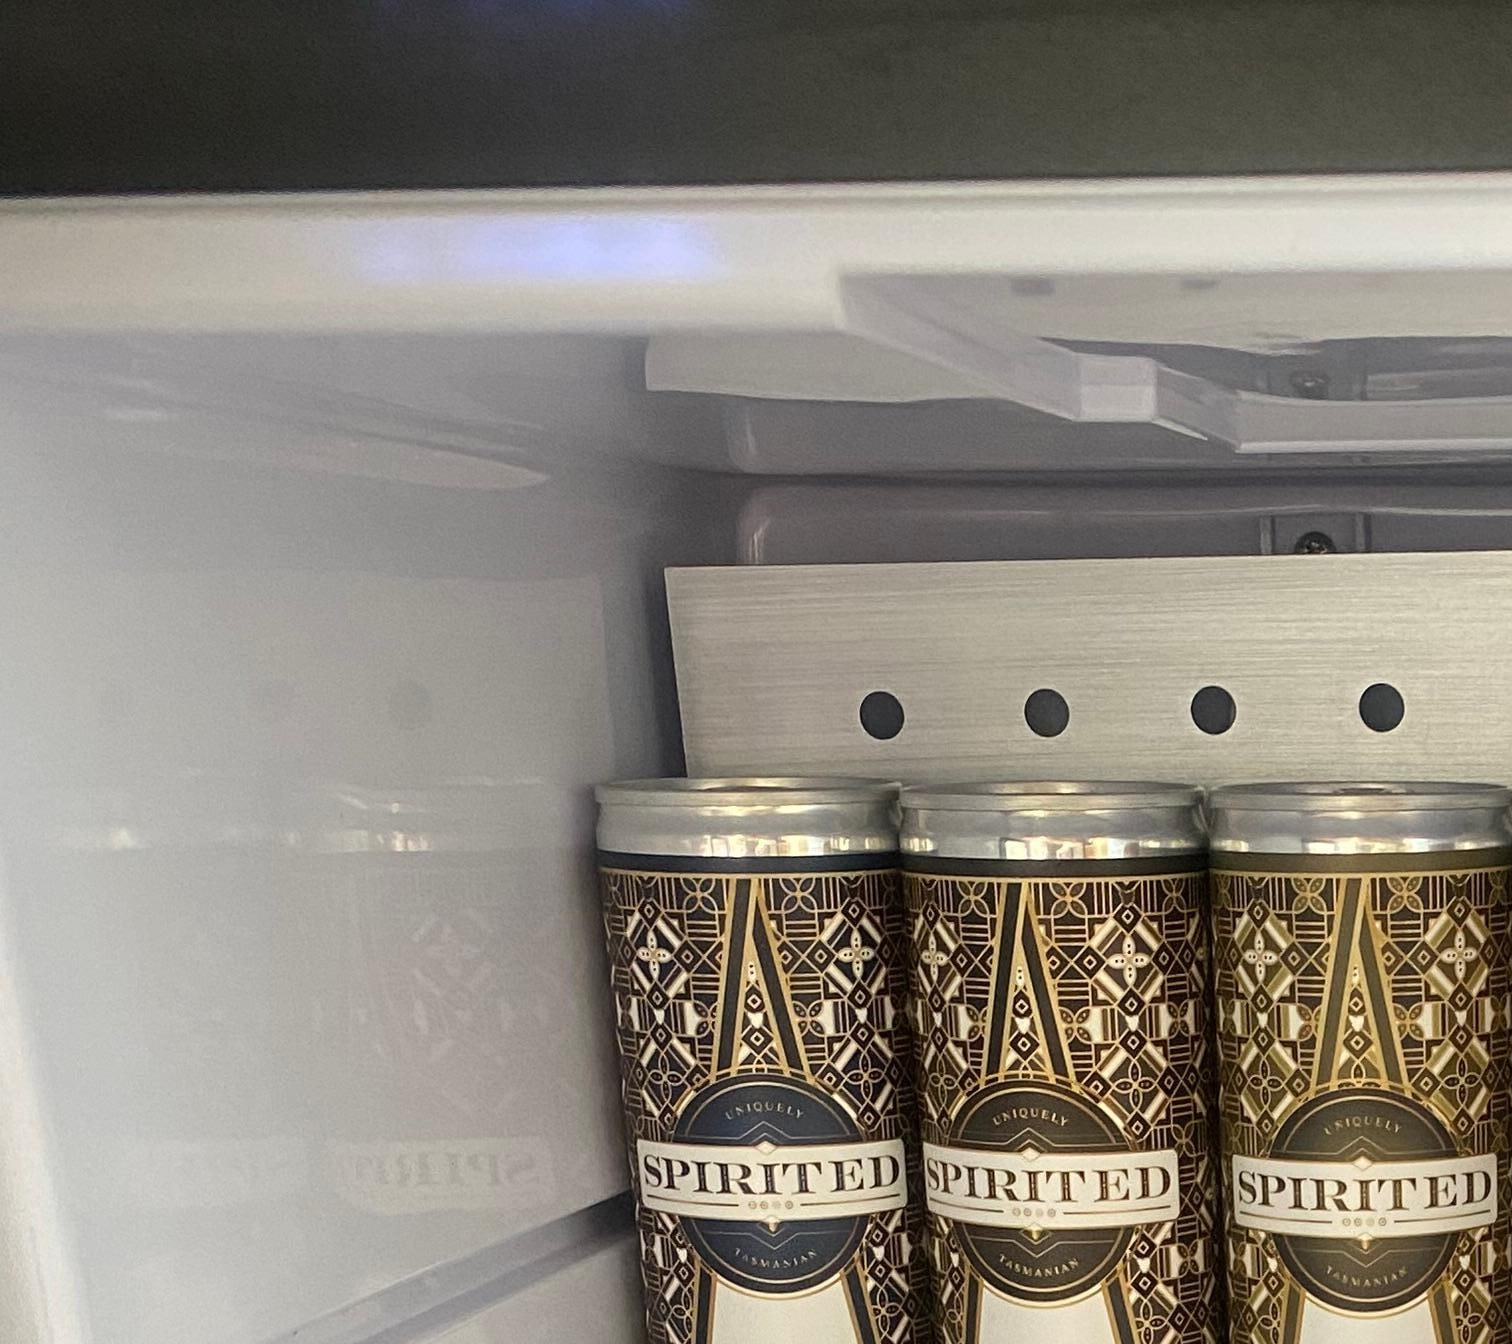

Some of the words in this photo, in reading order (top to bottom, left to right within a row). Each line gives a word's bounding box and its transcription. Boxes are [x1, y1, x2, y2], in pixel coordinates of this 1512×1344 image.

[724, 1101, 805, 1120] UNIQUELY
[992, 1107, 1070, 1127] UNIQUELY
[644, 1154, 900, 1195] SPIRITED
[926, 1157, 1172, 1203] SPIRITED
[1238, 1169, 1492, 1212] SPIRITED
[1000, 1253, 1079, 1277] TASMANIAN
